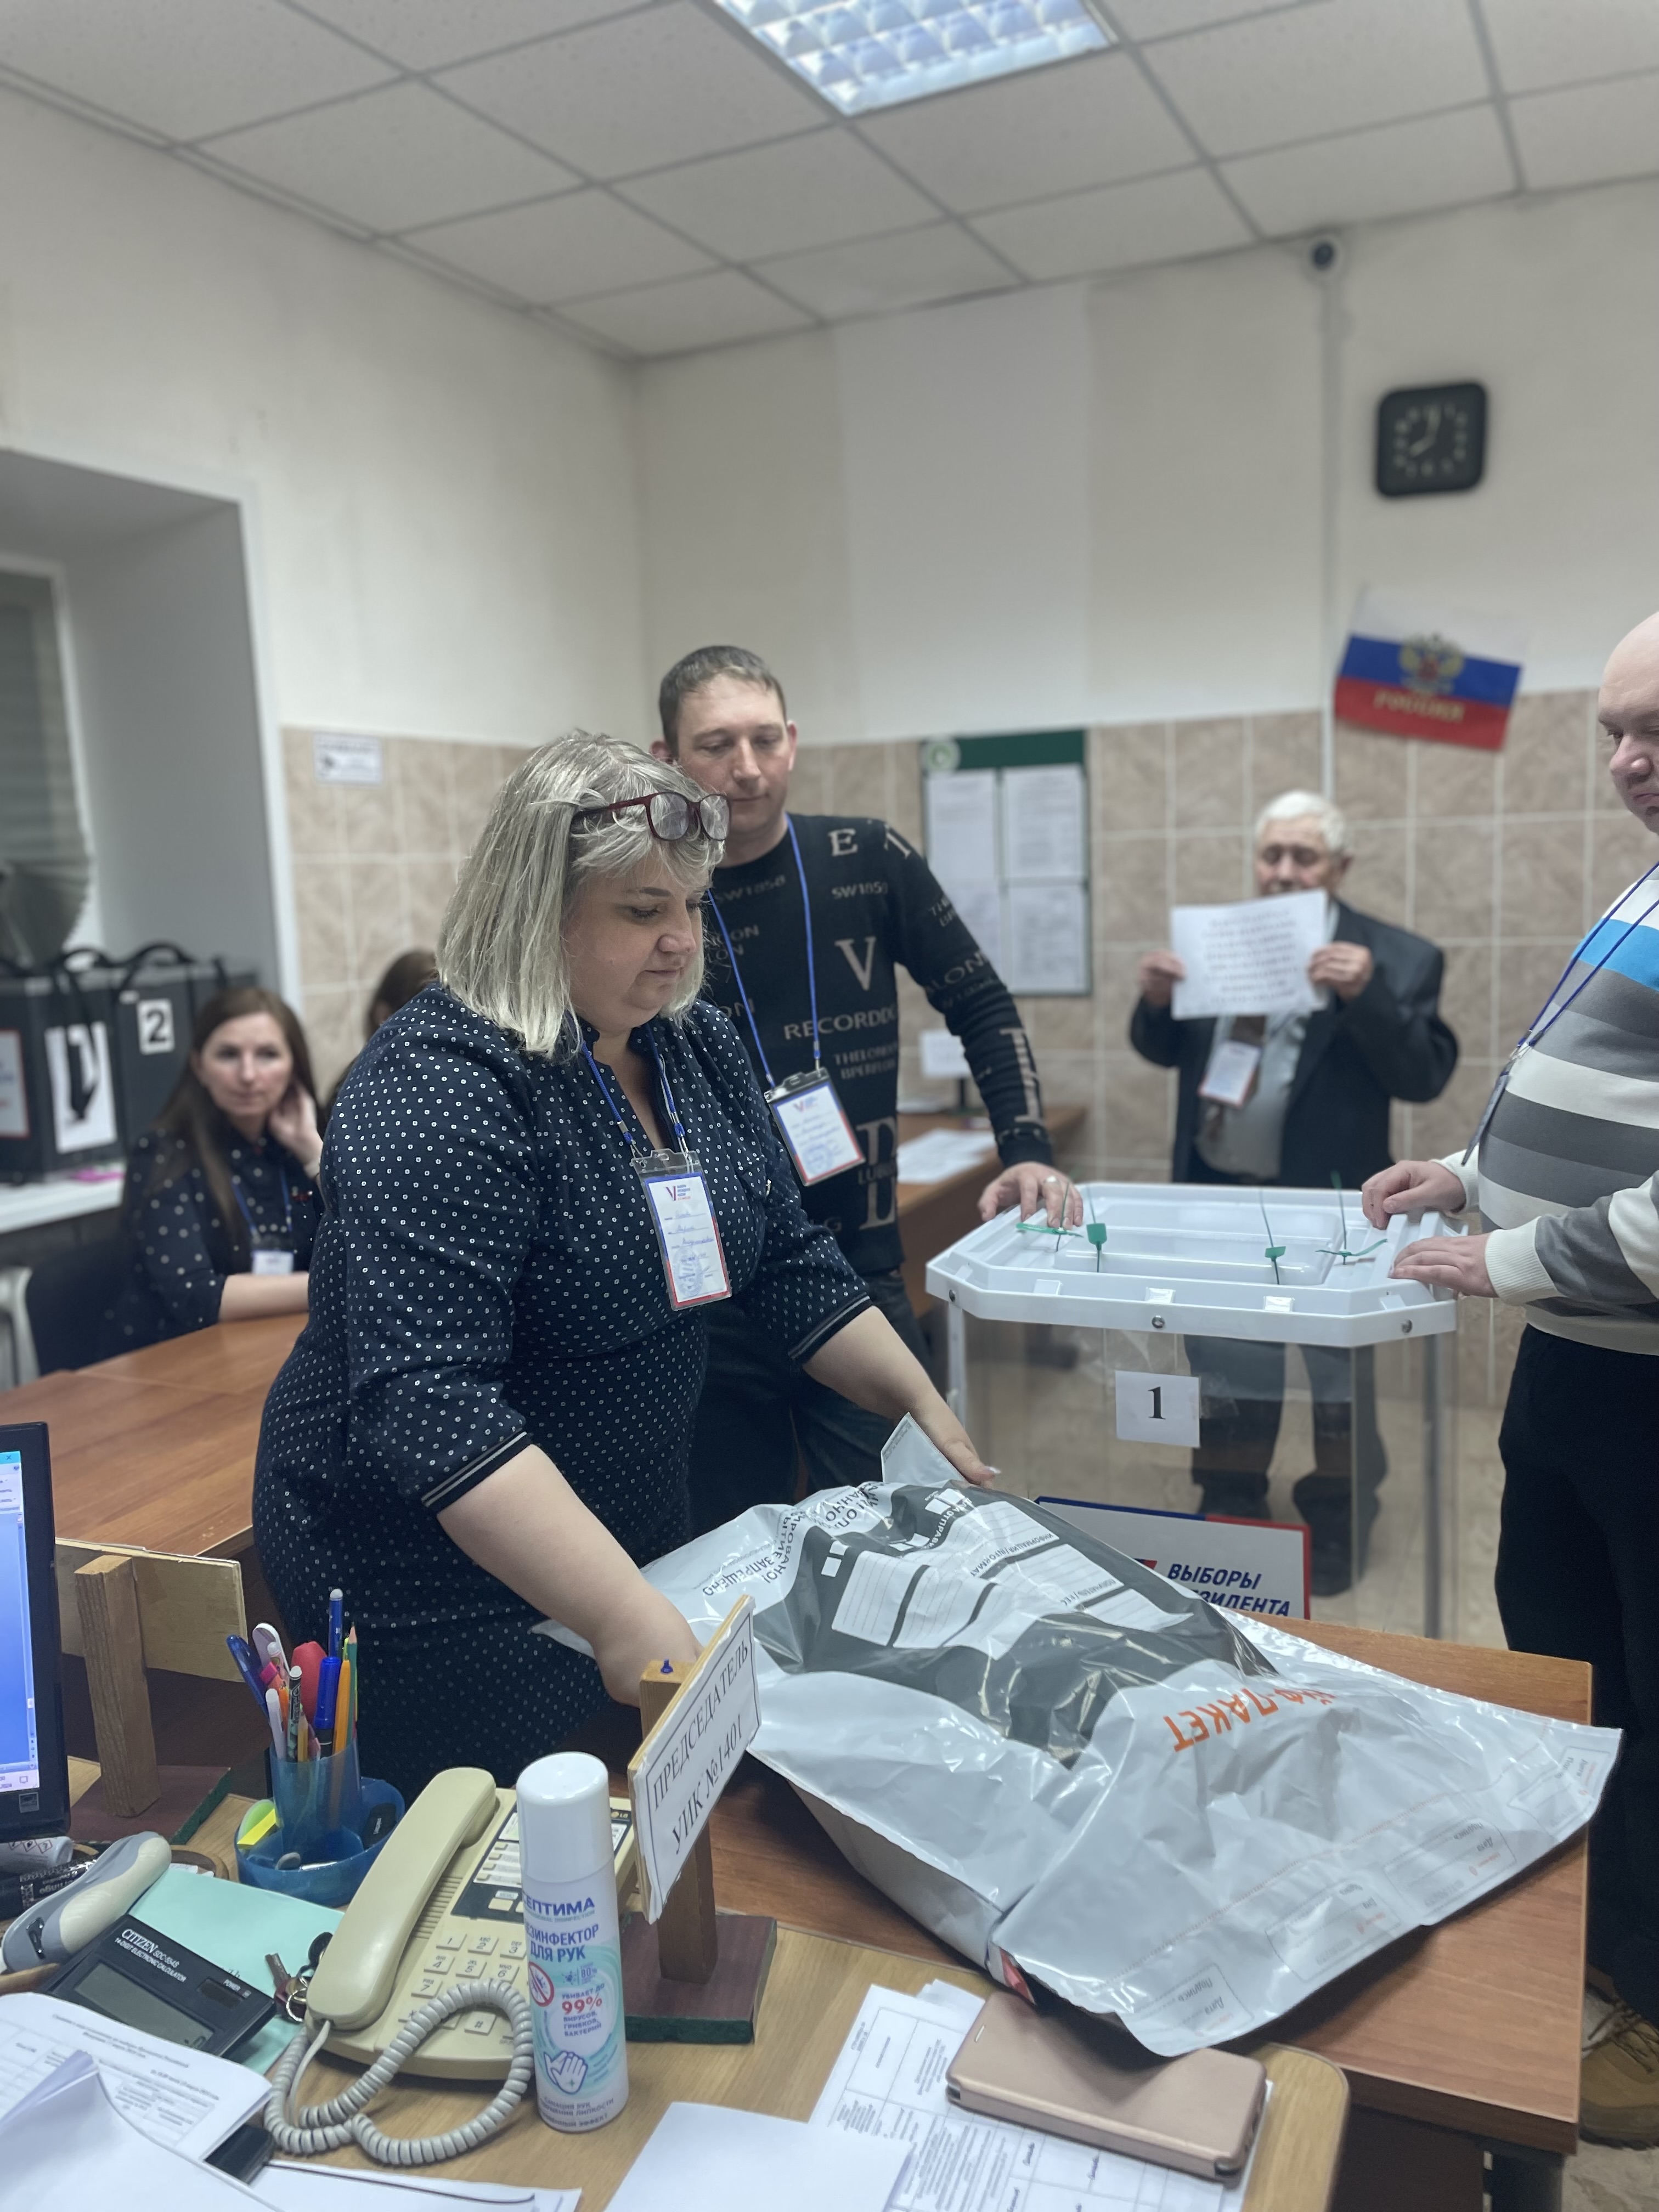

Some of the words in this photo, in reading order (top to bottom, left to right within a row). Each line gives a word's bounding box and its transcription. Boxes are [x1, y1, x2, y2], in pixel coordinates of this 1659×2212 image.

[834, 936, 877, 991] V
[146, 1009, 166, 1042] 2
[1148, 1386, 1166, 1420] 1
[702, 1556, 775, 1596] ЗАПРЕЩЕНО
[969, 1548, 1006, 1578] INFORMAT
[1167, 1564, 1262, 1590] ВЫБОРЫ
[1192, 1590, 1290, 1617] ЗИДЕНТА
[653, 1640, 749, 1811] ПРЕДСЕДАТЕЛЬ
[672, 1781, 704, 1855] УИК
[121, 1928, 159, 1954] CITIZEN
[476, 1942, 487, 1950] 2
[526, 1923, 599, 1946] ЕЗИНФЕКТОР
[508, 1946, 519, 1954] 3
[531, 1940, 553, 1962] ДЛЯ
[557, 1944, 586, 1963] РУК
[131, 1947, 160, 1967] ELECTRONIC
[156, 1961, 187, 1983] CALCULATOR
[496, 1970, 507, 1978] 6
[223, 1979, 241, 1991] POWER
[561, 1989, 594, 2000] УБИВАЕТ
[595, 1983, 605, 1993] ДО
[1177, 1977, 1212, 2002] Подпись
[562, 1993, 602, 2015] 99%
[1204, 1995, 1224, 2016] Дата
